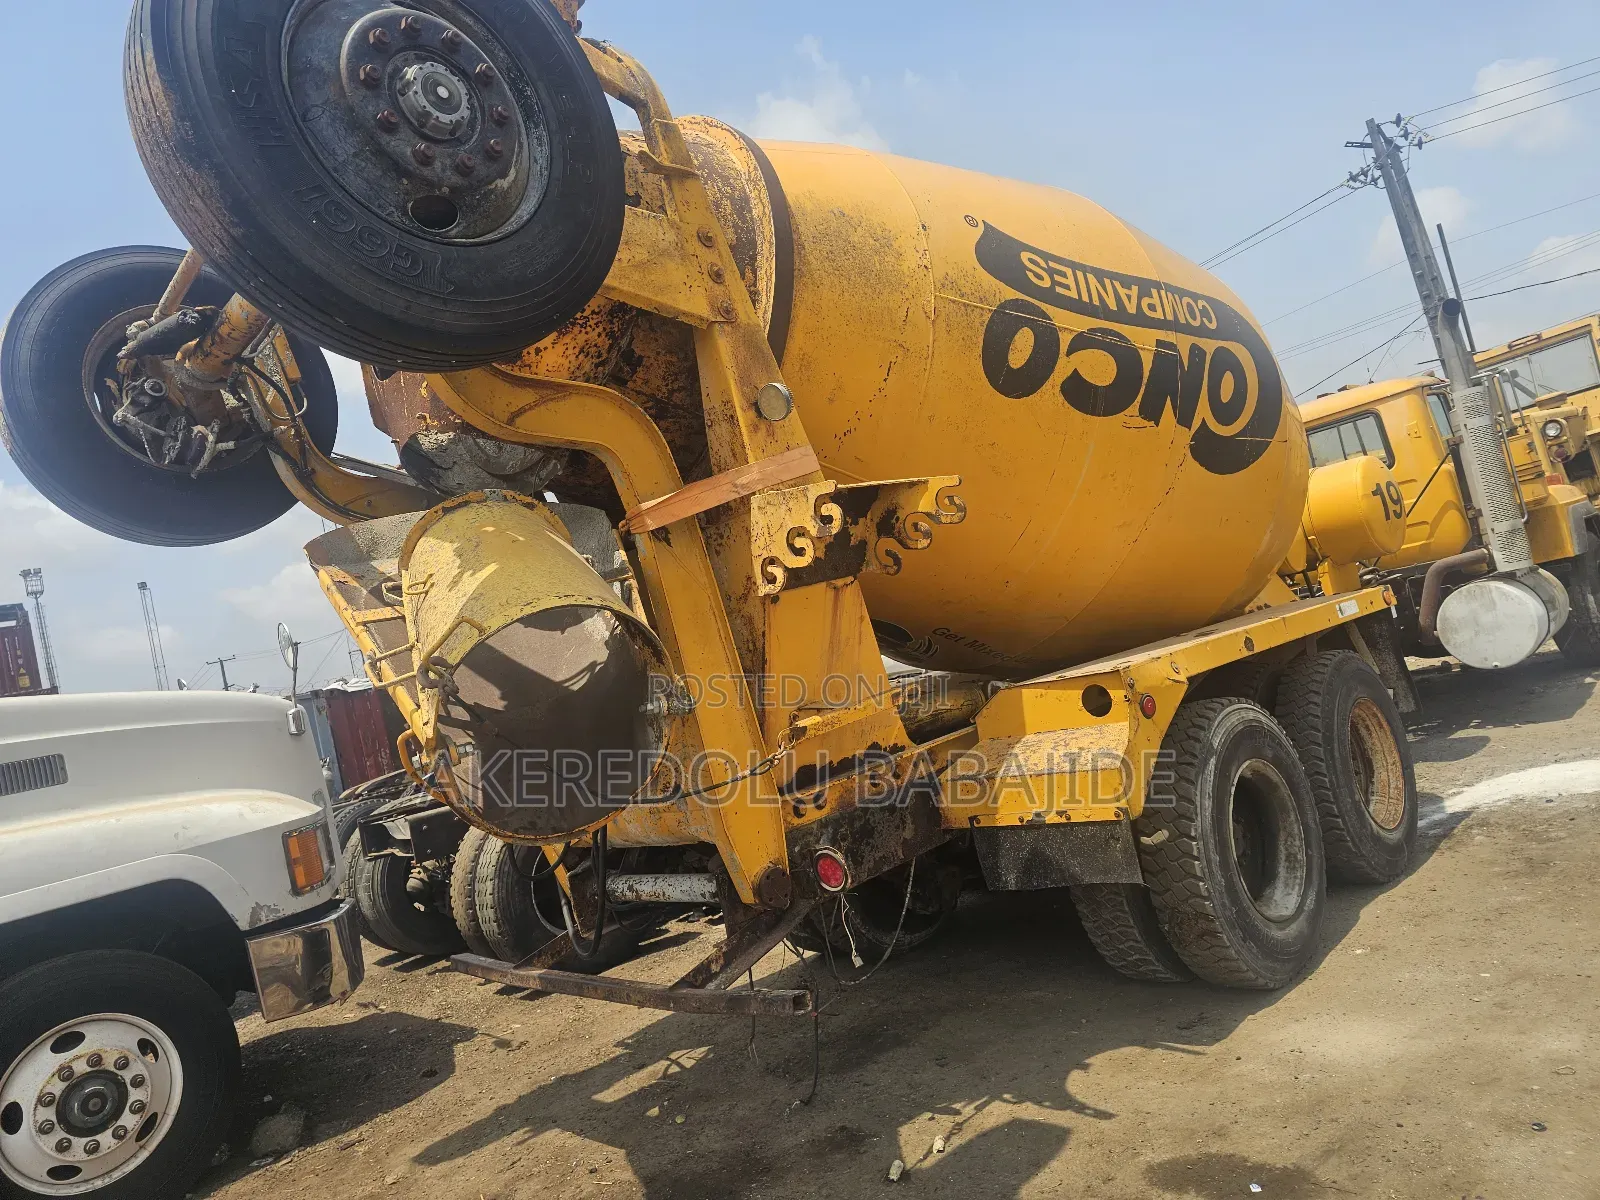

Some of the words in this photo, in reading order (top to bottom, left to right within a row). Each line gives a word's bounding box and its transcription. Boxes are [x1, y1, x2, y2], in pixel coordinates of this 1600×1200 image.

[298, 185, 426, 278] G661
[1020, 250, 1218, 331] COMPANIES
[982, 297, 1283, 475] CONCO
[1371, 480, 1403, 521] 19
[932, 627, 966, 644] Get
